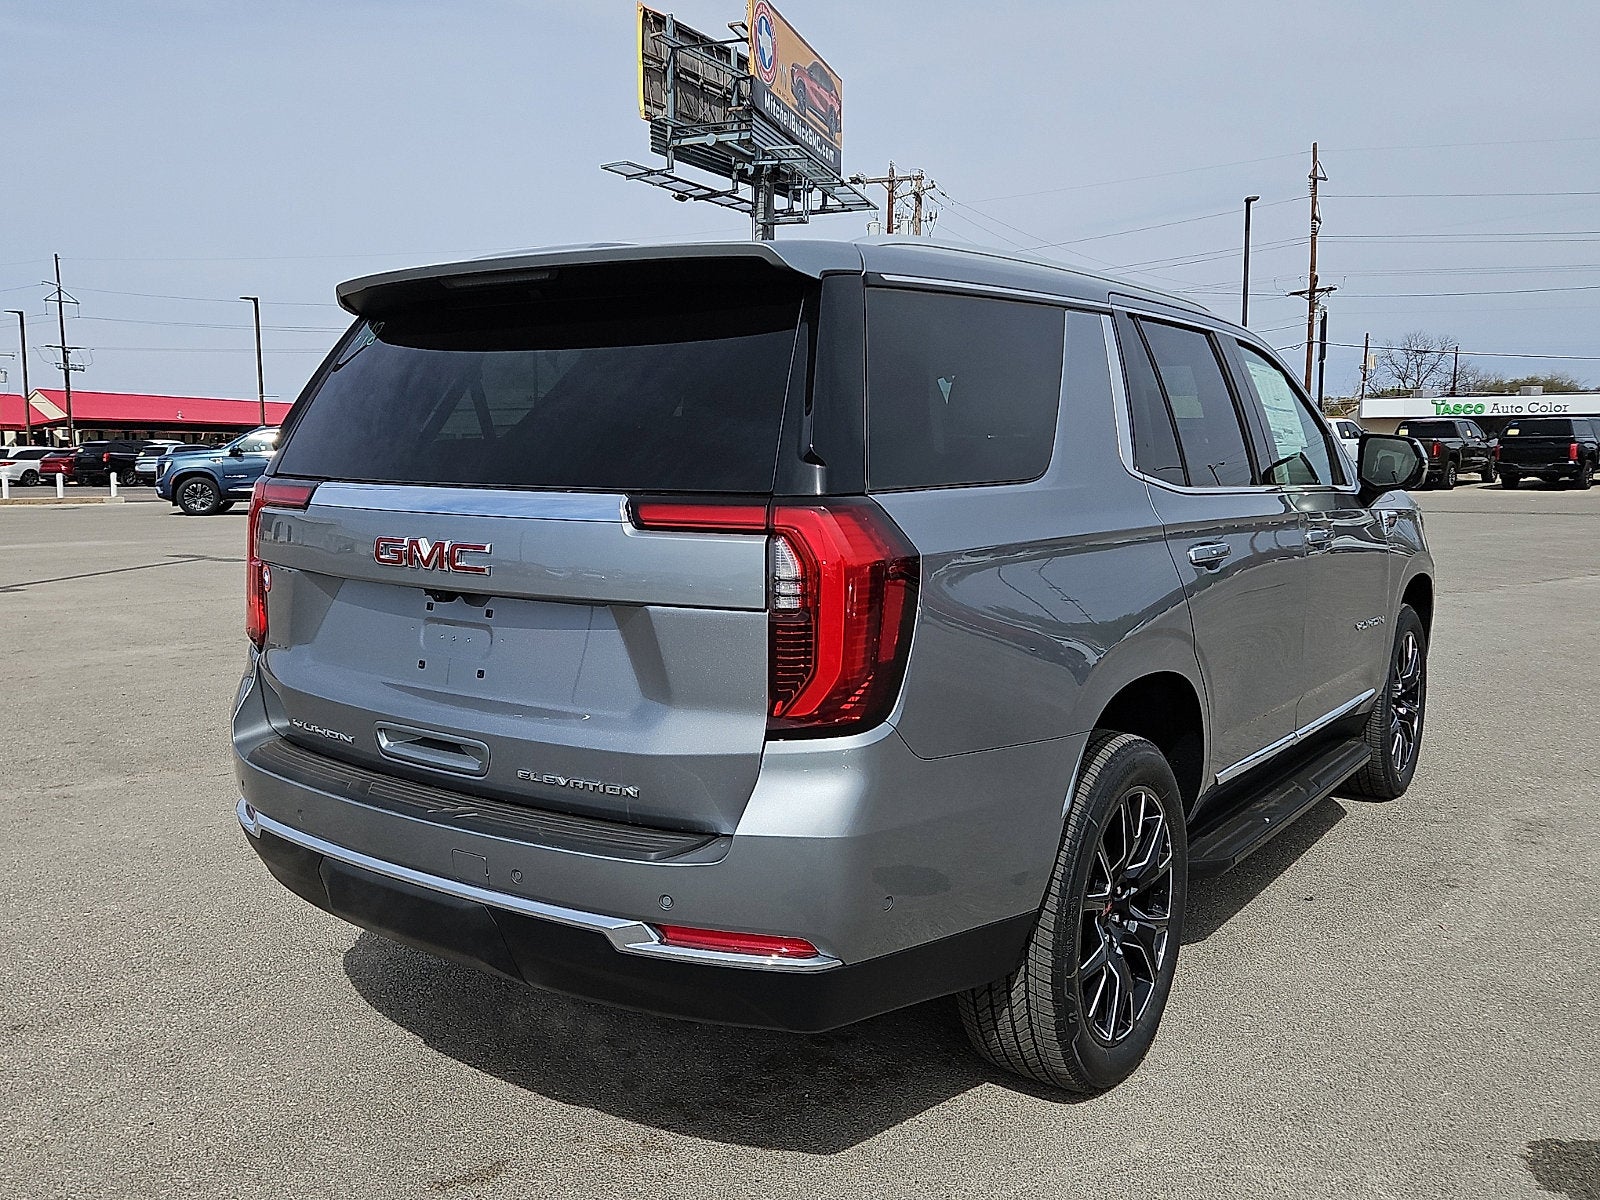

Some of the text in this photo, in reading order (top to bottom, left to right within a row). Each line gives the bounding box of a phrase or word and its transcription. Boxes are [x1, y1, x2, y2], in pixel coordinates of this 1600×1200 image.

[764, 90, 835, 163] MitchellBuickGMC.com
[1489, 402, 1524, 414] Auto
[1527, 401, 1570, 414] Color
[374, 535, 493, 577] GMC
[292, 718, 356, 745] YUKON
[516, 768, 640, 799] ELEVATION
